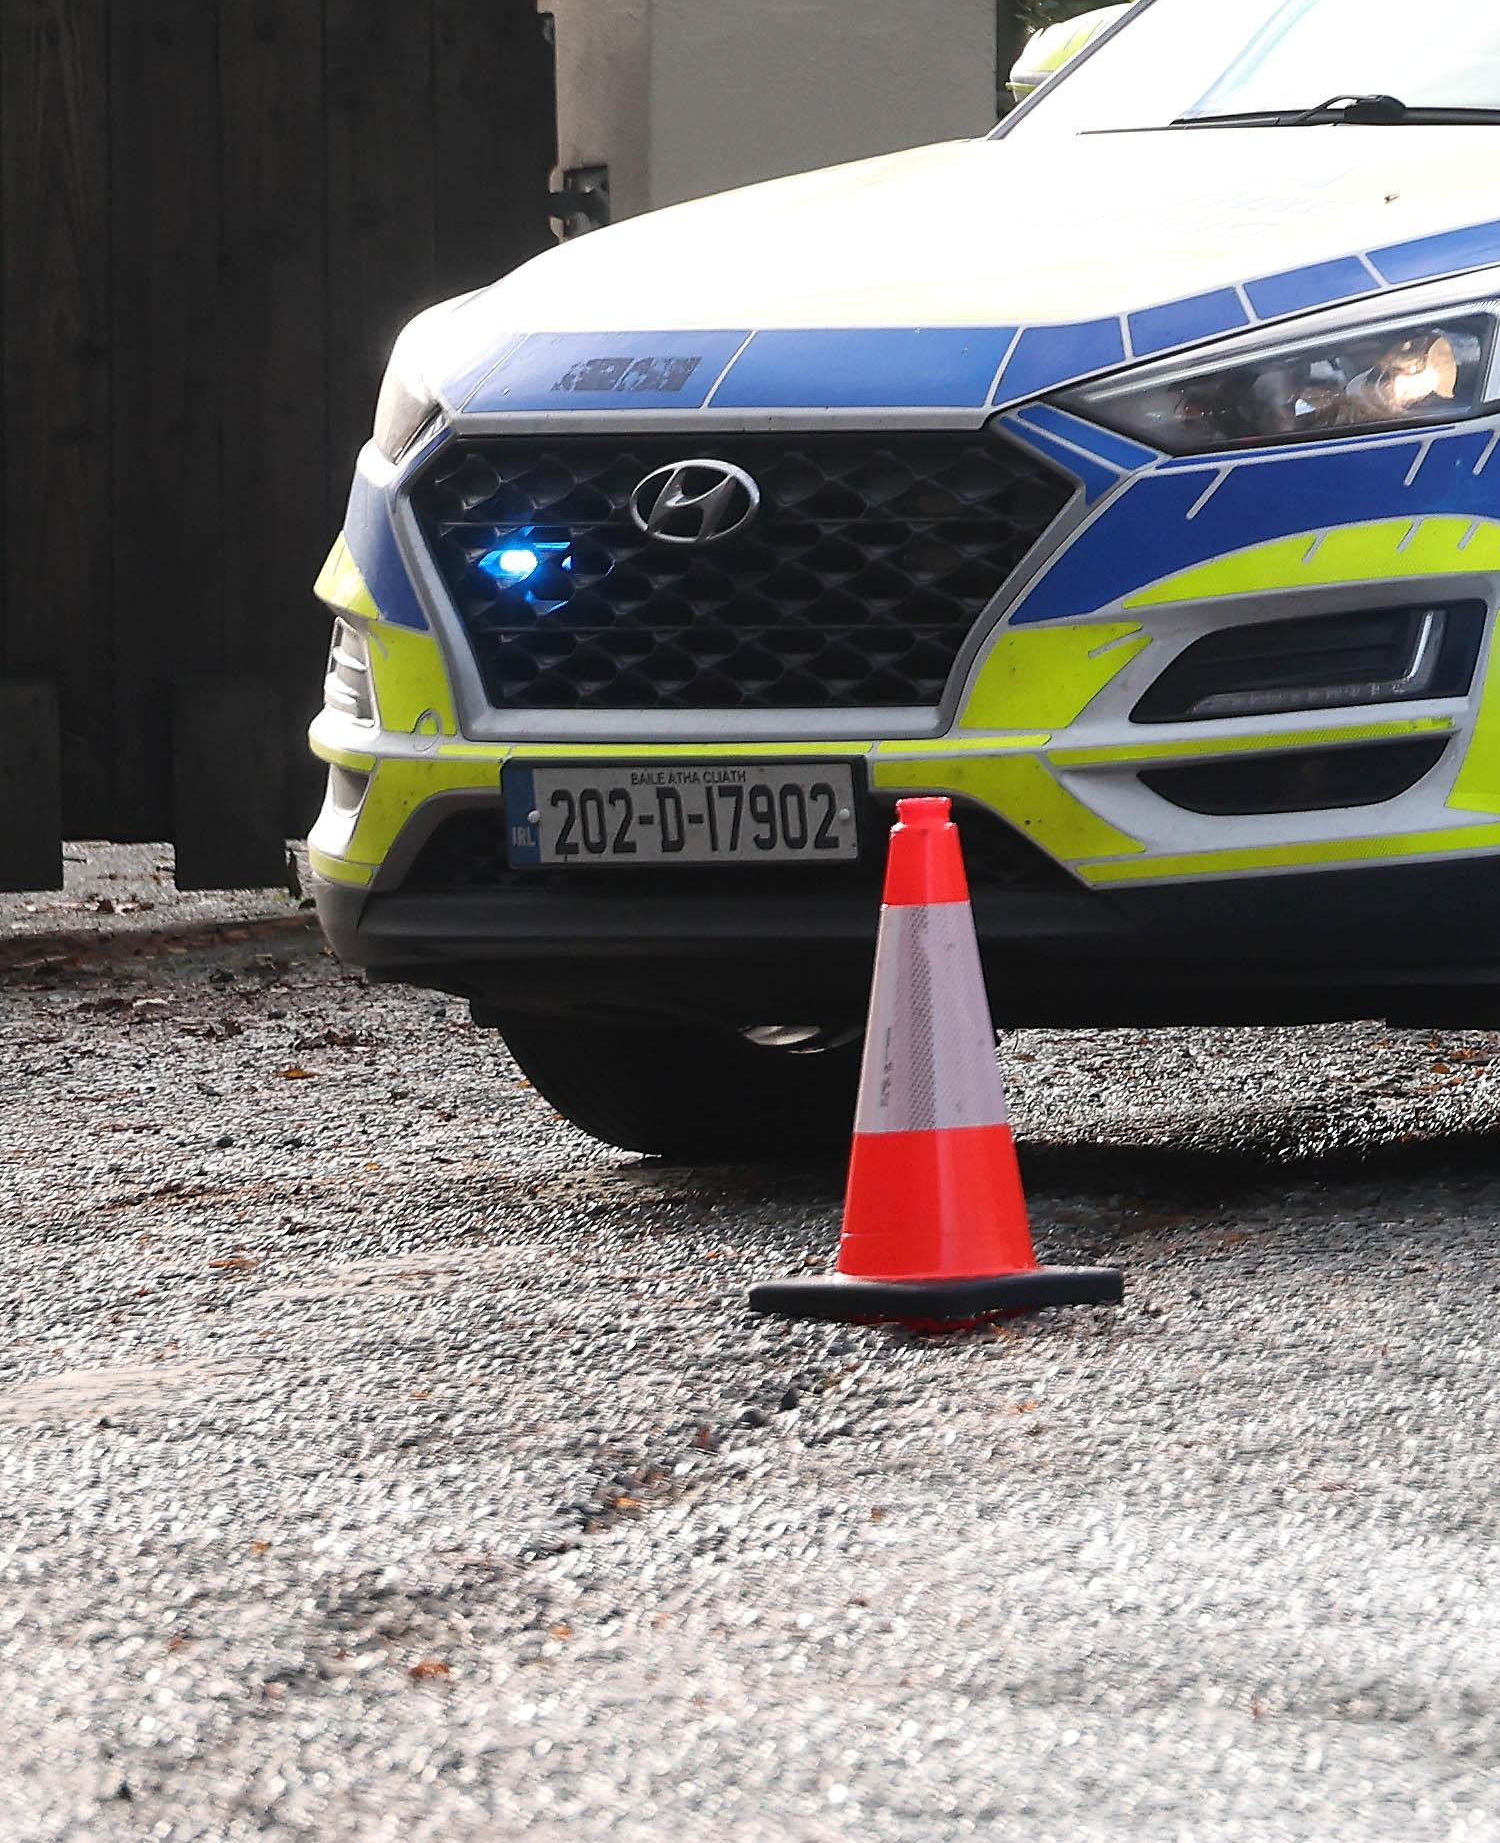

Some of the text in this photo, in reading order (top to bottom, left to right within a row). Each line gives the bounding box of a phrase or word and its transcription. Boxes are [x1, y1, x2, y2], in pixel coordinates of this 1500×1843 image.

[630, 769, 665, 785] BAILE
[703, 768, 746, 783] CLIATH
[550, 783, 840, 855] 202-D-17902
[511, 825, 536, 846] IRL
